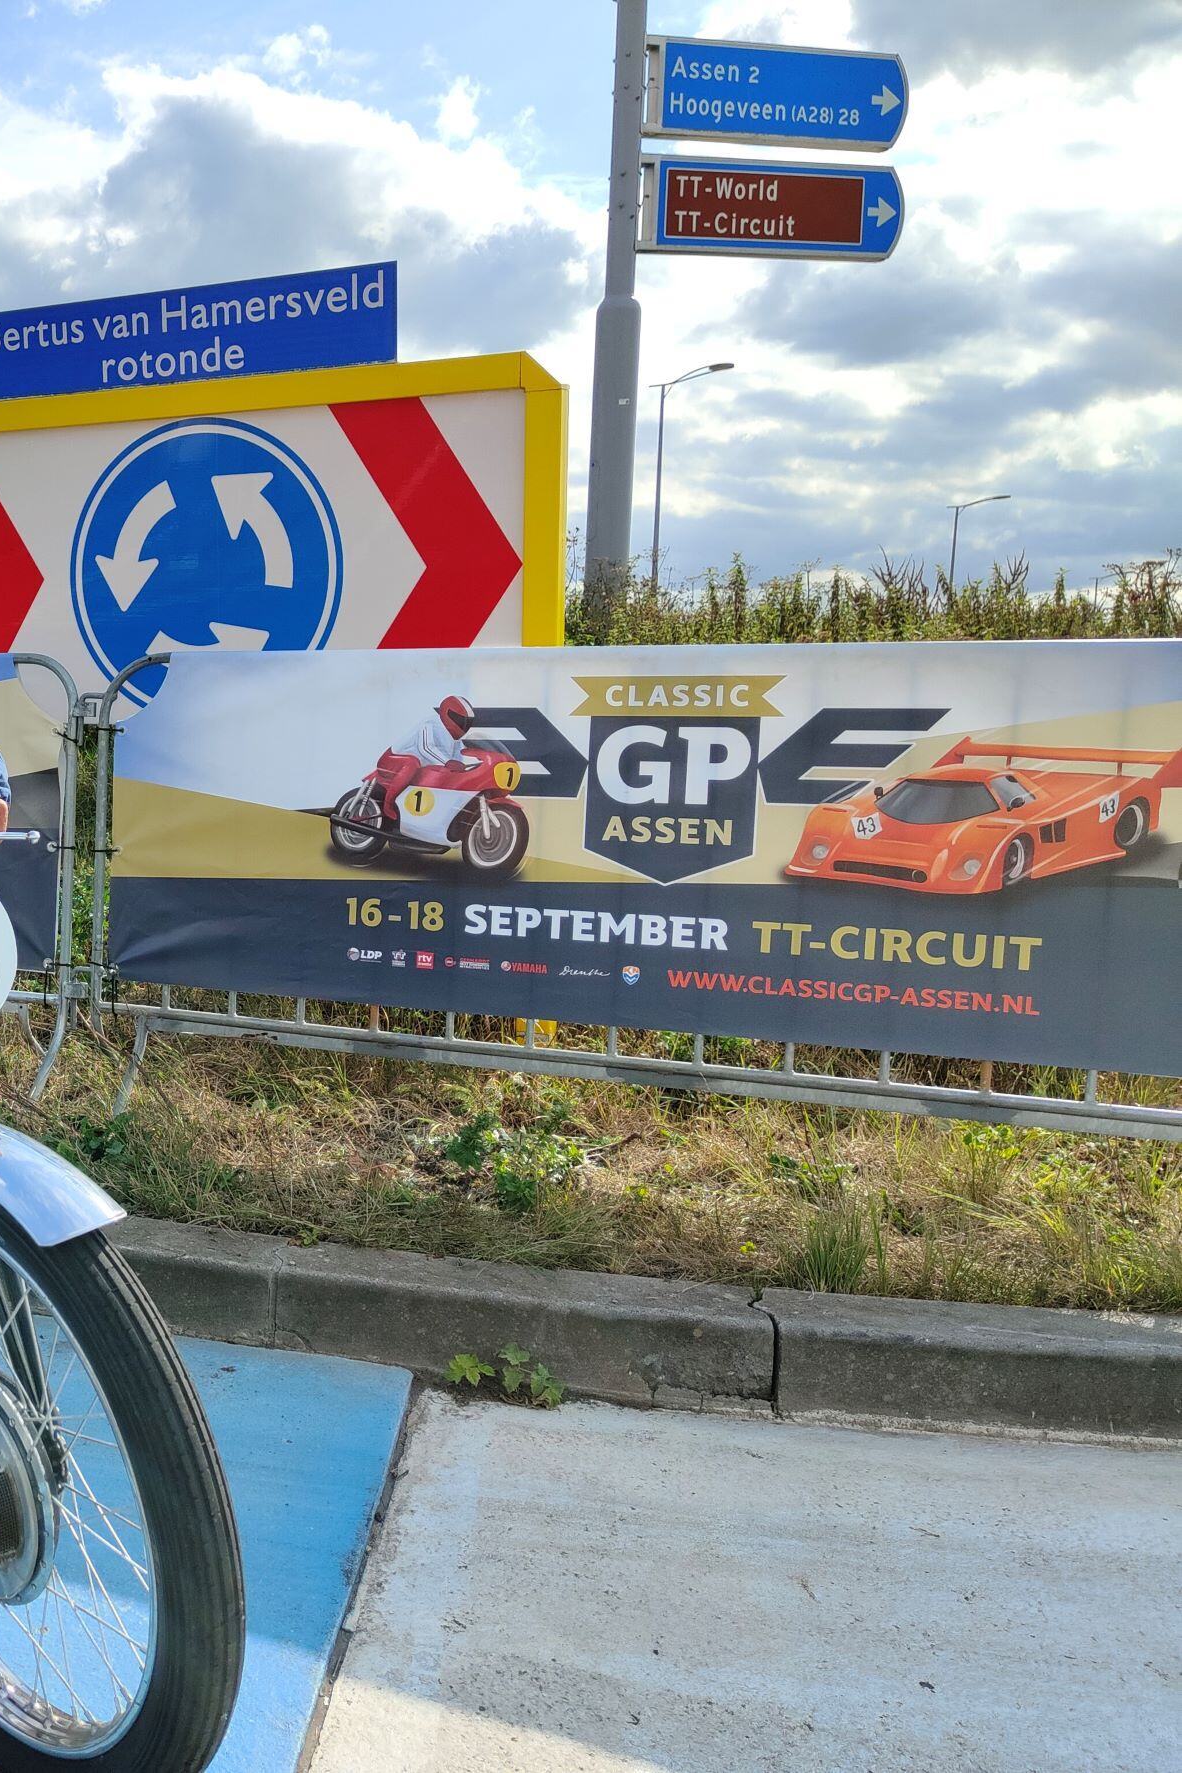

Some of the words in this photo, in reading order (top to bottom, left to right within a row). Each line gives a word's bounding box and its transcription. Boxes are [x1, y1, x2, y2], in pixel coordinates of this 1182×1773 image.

[671, 56, 740, 84] Assen
[748, 66, 760, 84] 2
[669, 92, 786, 123] Hoogeveen
[790, 105, 834, 125] (A28)
[838, 108, 860, 127] 28
[676, 176, 778, 202] TT-World
[674, 210, 795, 237] TT-Circuit
[92, 312, 149, 342] van
[161, 270, 385, 333] Hamersveld
[101, 336, 246, 383] rotonde
[605, 684, 749, 707] CLASSIC
[506, 767, 514, 788] 1
[596, 725, 752, 805] GP
[414, 790, 423, 812] 1
[1100, 798, 1116, 817] 43
[601, 815, 733, 846] ASSEN
[856, 816, 877, 836] 43
[464, 903, 729, 951] SEPTEMBER
[752, 920, 1043, 971] TT-CIRCUIT
[360, 949, 383, 960] LDP
[512, 962, 547, 974] YAMAHA
[667, 969, 1041, 1016] WWW.CLASSICGP-ASSEN.NL
